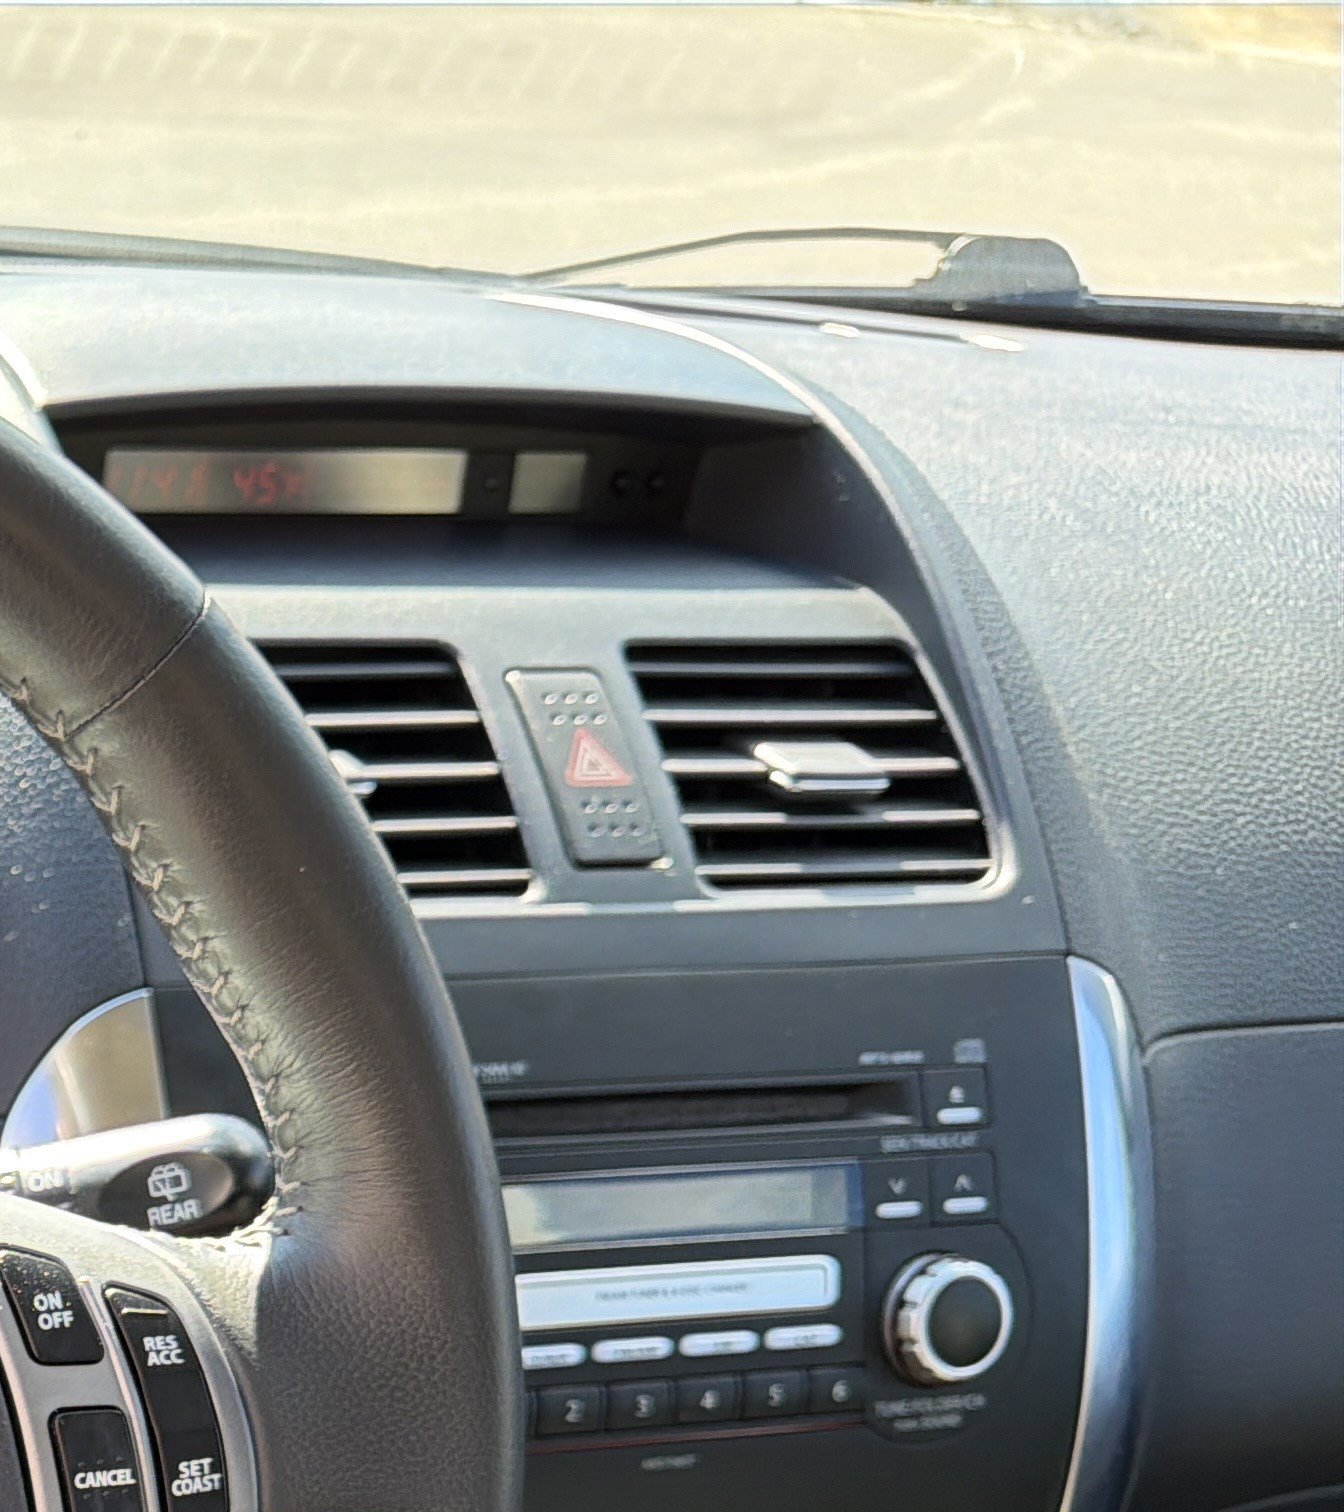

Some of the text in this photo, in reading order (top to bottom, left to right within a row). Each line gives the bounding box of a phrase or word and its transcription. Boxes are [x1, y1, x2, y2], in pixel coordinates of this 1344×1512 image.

[27, 1170, 62, 1193] ON
[146, 1198, 202, 1227] REAR
[34, 1292, 64, 1313] ON
[38, 1312, 74, 1331] OFF
[143, 1335, 179, 1352] RES
[147, 1347, 186, 1367] ACC
[178, 1457, 211, 1477] SET
[74, 1467, 137, 1489] CANCEL
[171, 1473, 223, 1496] COAST
